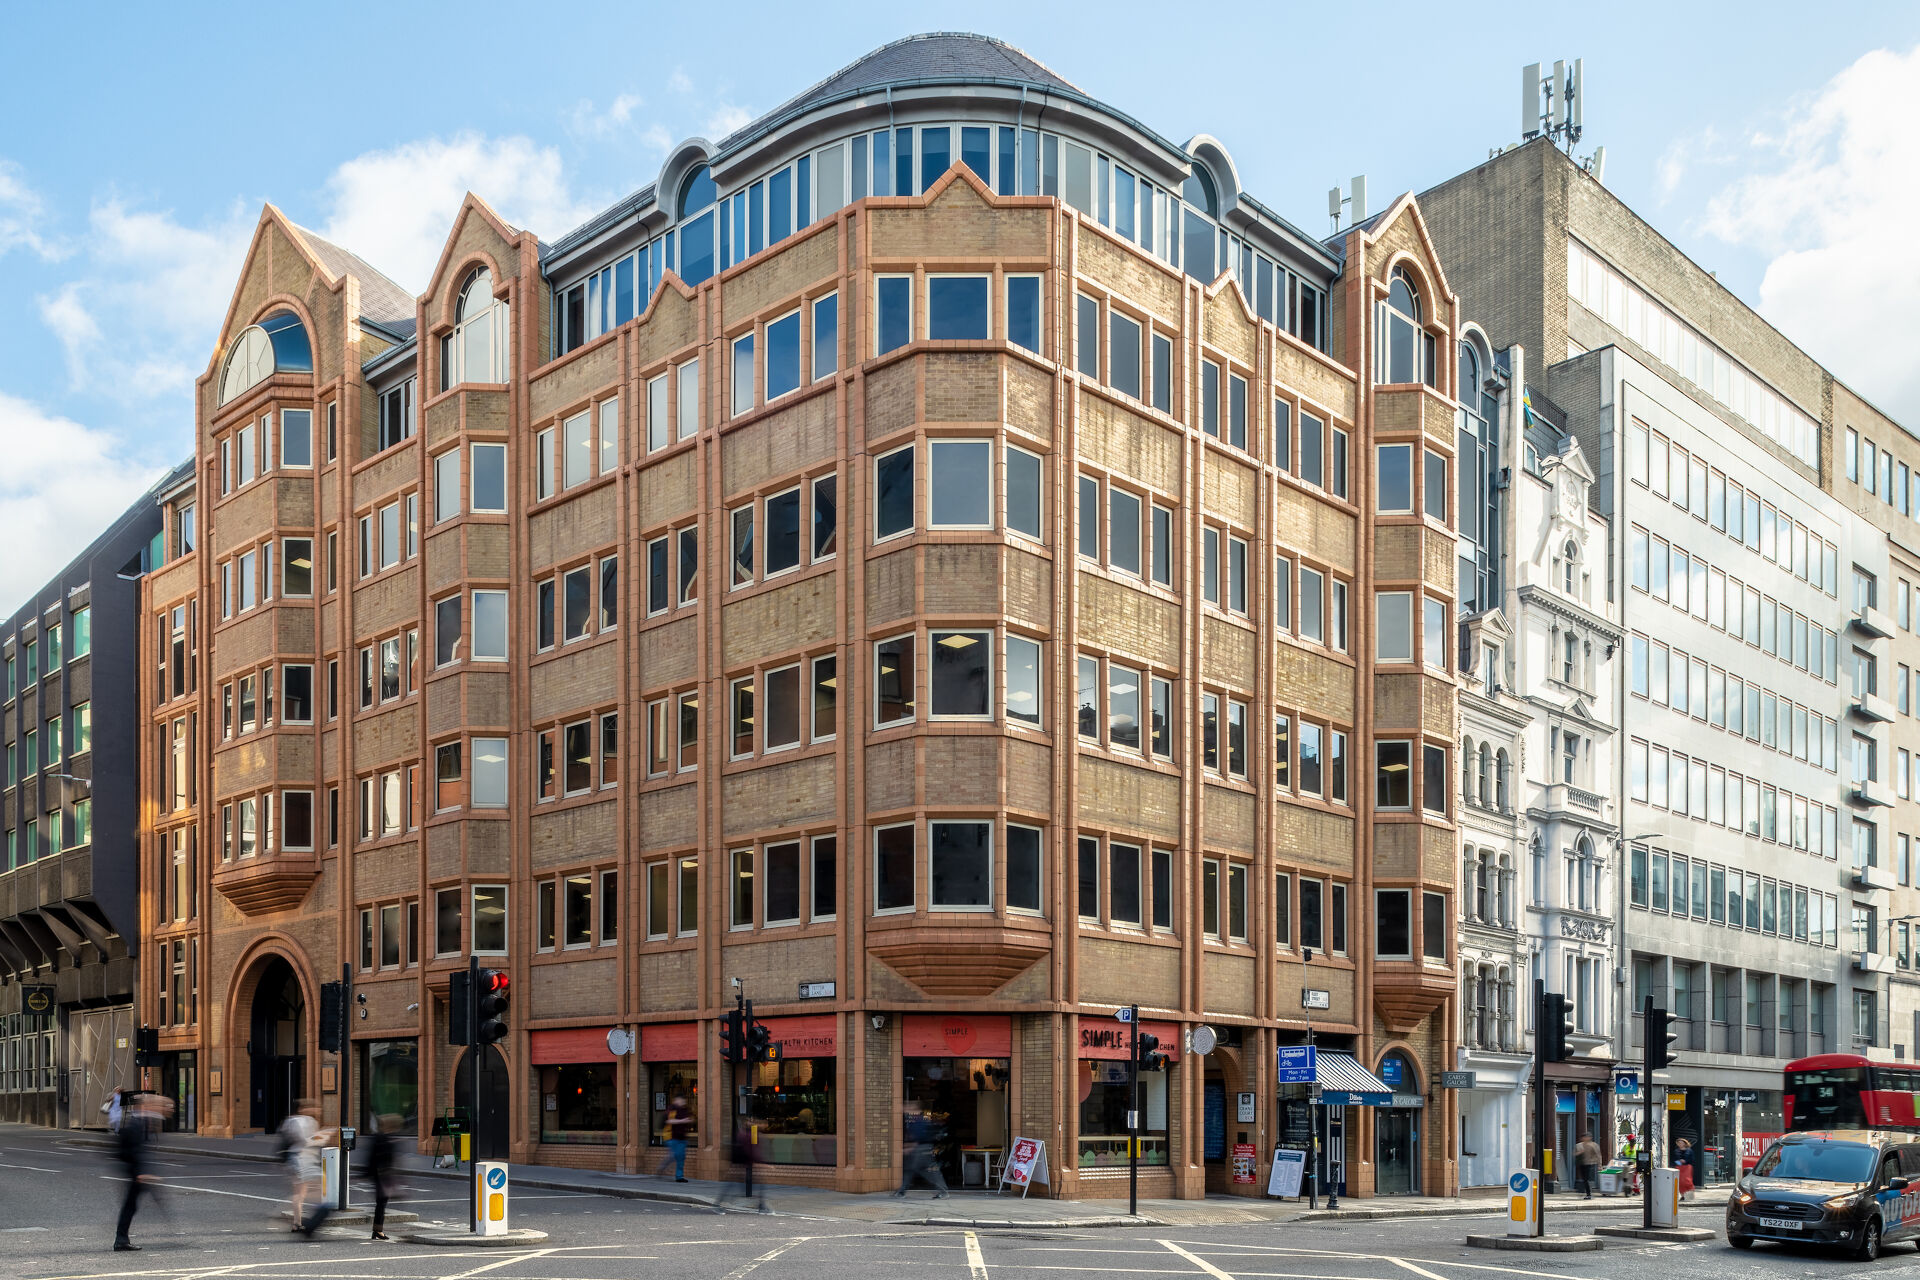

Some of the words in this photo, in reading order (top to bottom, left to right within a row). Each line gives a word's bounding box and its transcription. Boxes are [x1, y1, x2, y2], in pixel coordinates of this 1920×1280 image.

[944, 1027, 968, 1036] SIMPLE
[803, 1038, 833, 1046] KITCHEN
[1082, 1029, 1123, 1049] SIMPLE
[1714, 1098, 1726, 1108] Surge
[1742, 1138, 1761, 1156] RETAIL
[1883, 1191, 1920, 1223] AUTOF
[1762, 1218, 1783, 1227] YS22
